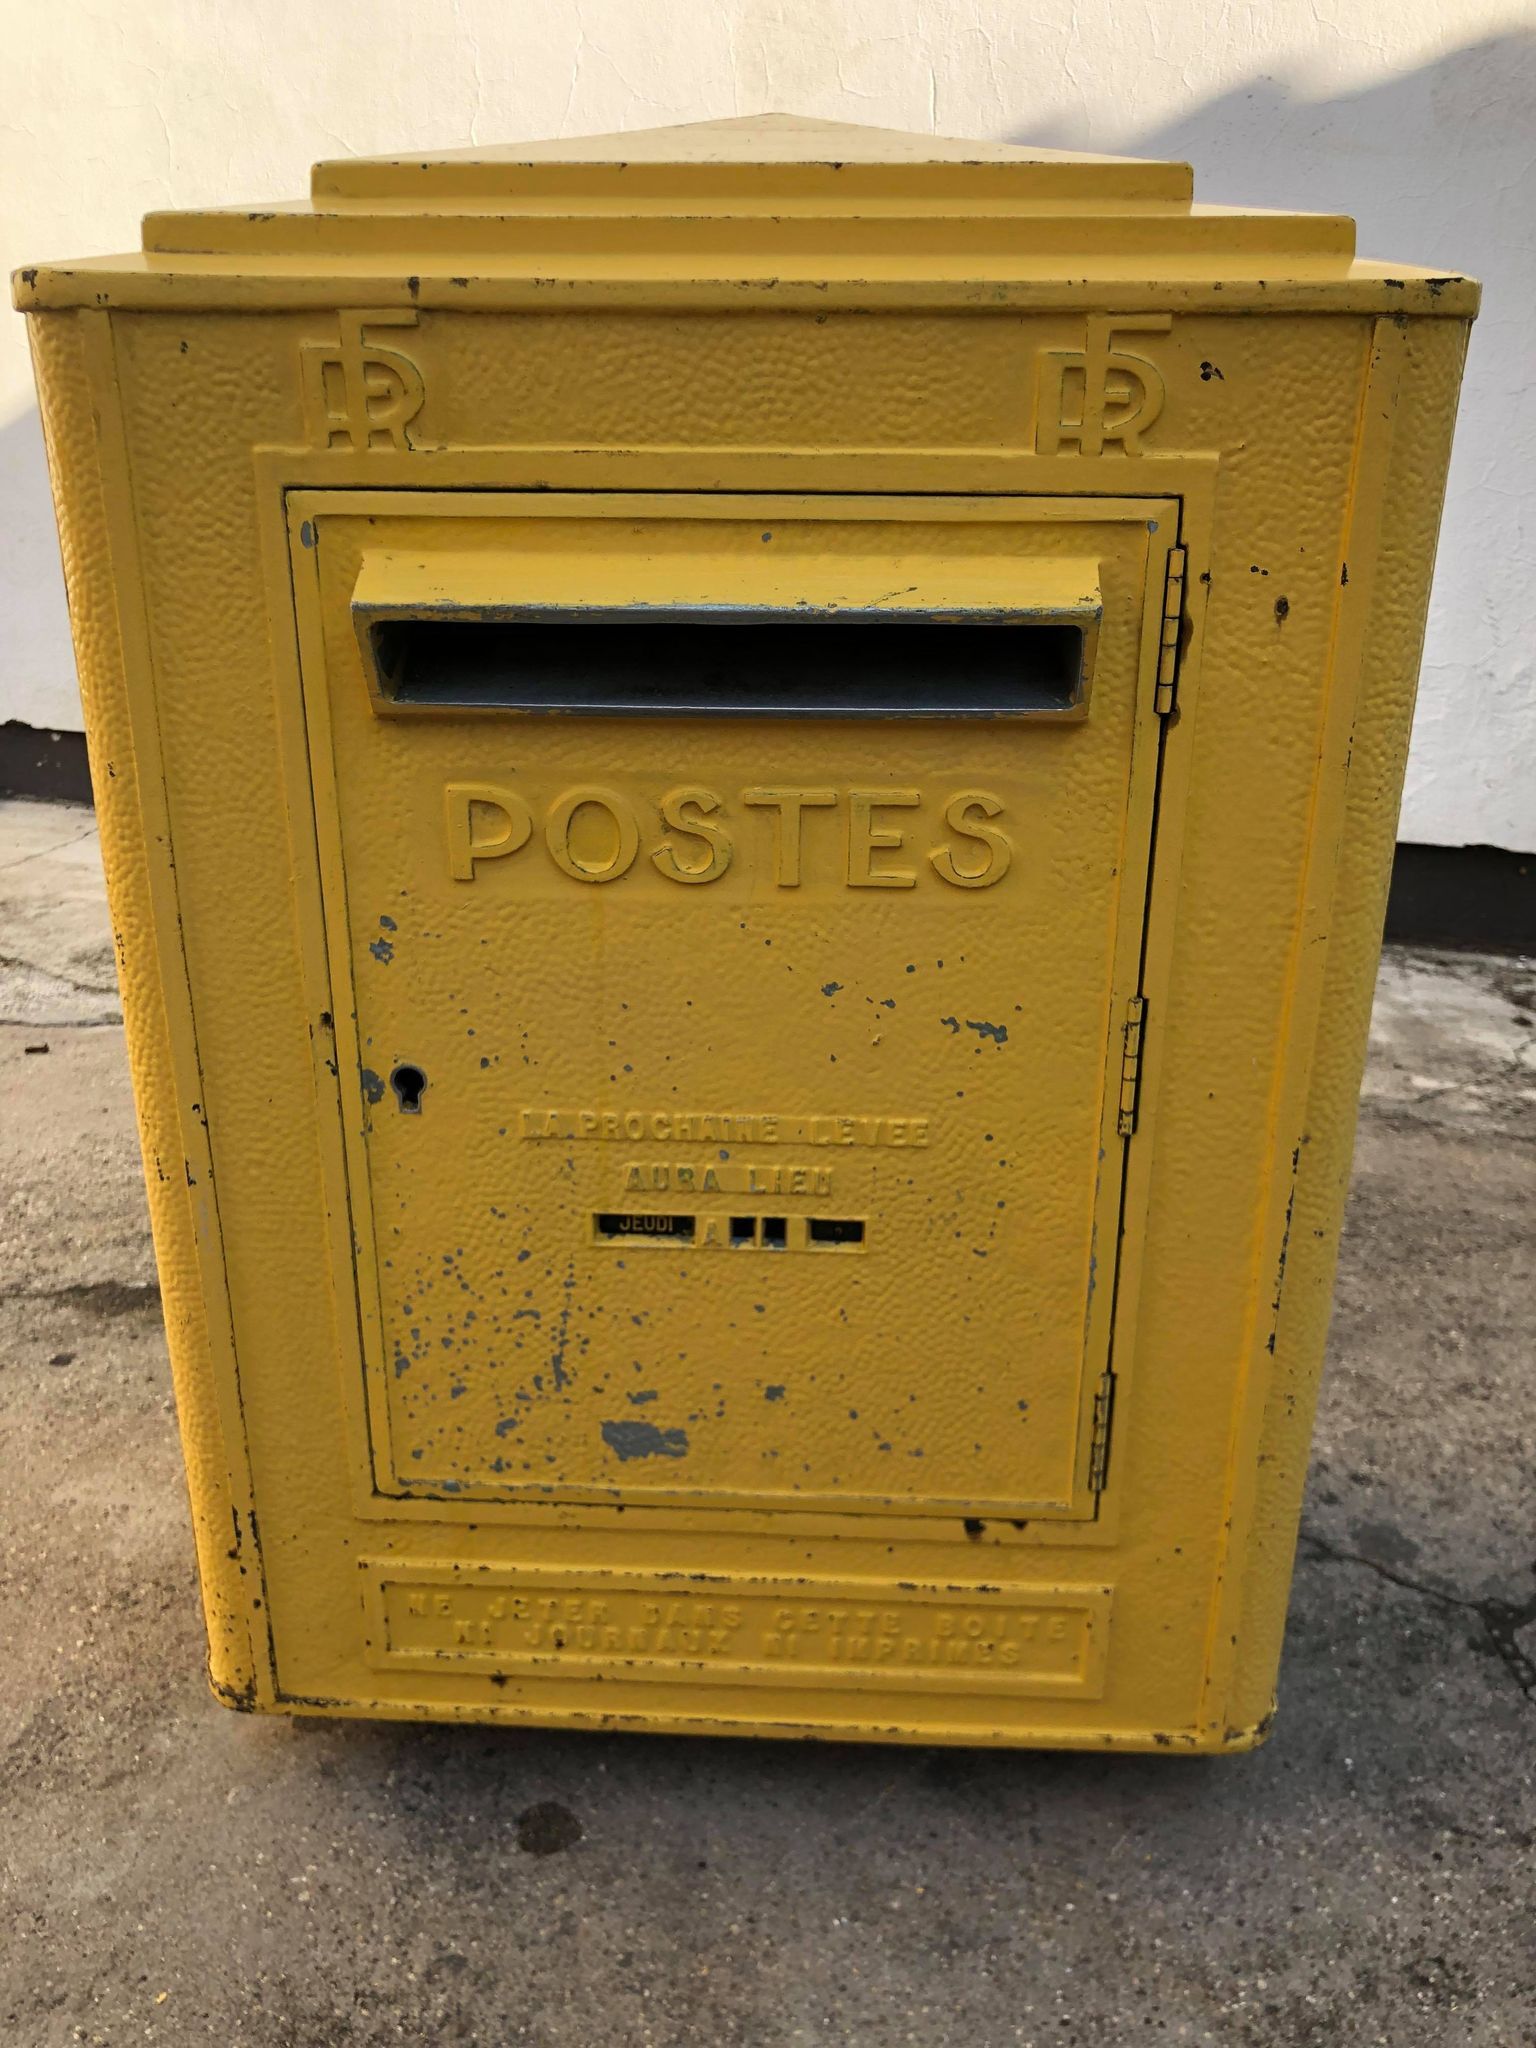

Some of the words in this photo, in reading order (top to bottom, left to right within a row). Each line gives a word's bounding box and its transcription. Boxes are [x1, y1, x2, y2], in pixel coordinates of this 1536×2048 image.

[445, 782, 1013, 889] POSTES
[521, 1110, 560, 1138] LA
[579, 1112, 779, 1143] PROCHAINE
[626, 1164, 723, 1192] AURA
[748, 1166, 832, 1195] LIEU
[618, 1214, 675, 1232] JEUDI
[409, 1594, 450, 1616] NE
[489, 1597, 607, 1624] JETER
[774, 1608, 901, 1634] CETTE
